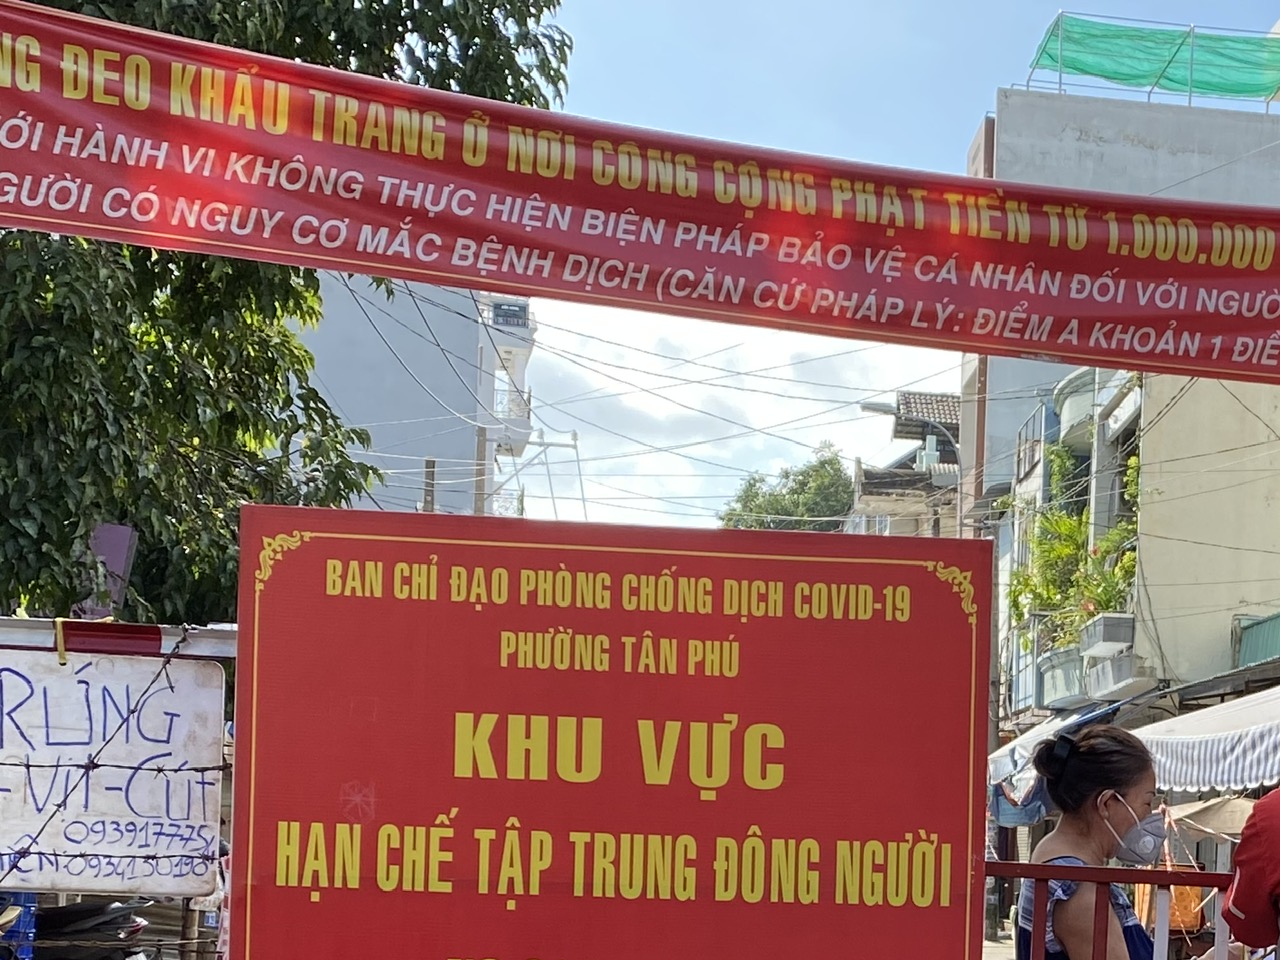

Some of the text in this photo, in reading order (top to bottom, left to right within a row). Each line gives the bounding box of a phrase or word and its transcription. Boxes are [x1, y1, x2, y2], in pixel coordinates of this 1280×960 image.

[0, 110, 45, 151] ỚI
[52, 120, 169, 170] HÀNH
[180, 144, 213, 176] VI
[225, 152, 364, 201] KHÔNG
[375, 174, 476, 219] THỰC
[485, 191, 573, 232] HIỆN
[581, 207, 666, 246] BIỆN
[674, 223, 770, 259] PHÁP
[777, 230, 853, 272] BẢO
[864, 245, 907, 283] VỆ
[914, 250, 959, 285] CÁ
[970, 262, 1062, 297] NHÂN
[1070, 267, 1125, 305] ĐỐI
[1136, 277, 1188, 310] VỚI
[60, 44, 152, 112] ĐEO
[169, 62, 290, 136] KHẨU
[308, 87, 446, 161] TRANG
[461, 110, 491, 167] Ở
[591, 139, 698, 199] CÔNG
[713, 160, 816, 219] CỘNG
[830, 176, 928, 237] PHẠT
[943, 186, 1031, 244] TIỀN
[1102, 211, 1276, 272] 1.000.000
[102, 184, 160, 222] CÓ
[171, 197, 285, 239] NGUY
[291, 214, 350, 249] CƠ
[356, 215, 443, 263] MẮC
[450, 237, 555, 279] BỆNH
[562, 253, 651, 292] DỊCH
[656, 266, 747, 304] (CĂN
[753, 279, 808, 312] CỨ
[810, 287, 905, 324] PHÁP
[911, 297, 965, 333] LÝ:
[972, 300, 1053, 343] ĐIỂM
[1058, 319, 1079, 346] A
[1089, 320, 1202, 359] KHOẢN
[1210, 336, 1223, 361] 1
[325, 554, 911, 625] BAN CHỈ ĐẠO PHÒNG CHỐNG DỊCH COVID-19
[500, 626, 740, 678] PHƯỜNG TÂN PHÚ
[454, 711, 786, 802] KHU VỰC
[276, 807, 952, 911] HẠN CHẾ TẬP TRUNG ĐÔNG NGƯỜI
